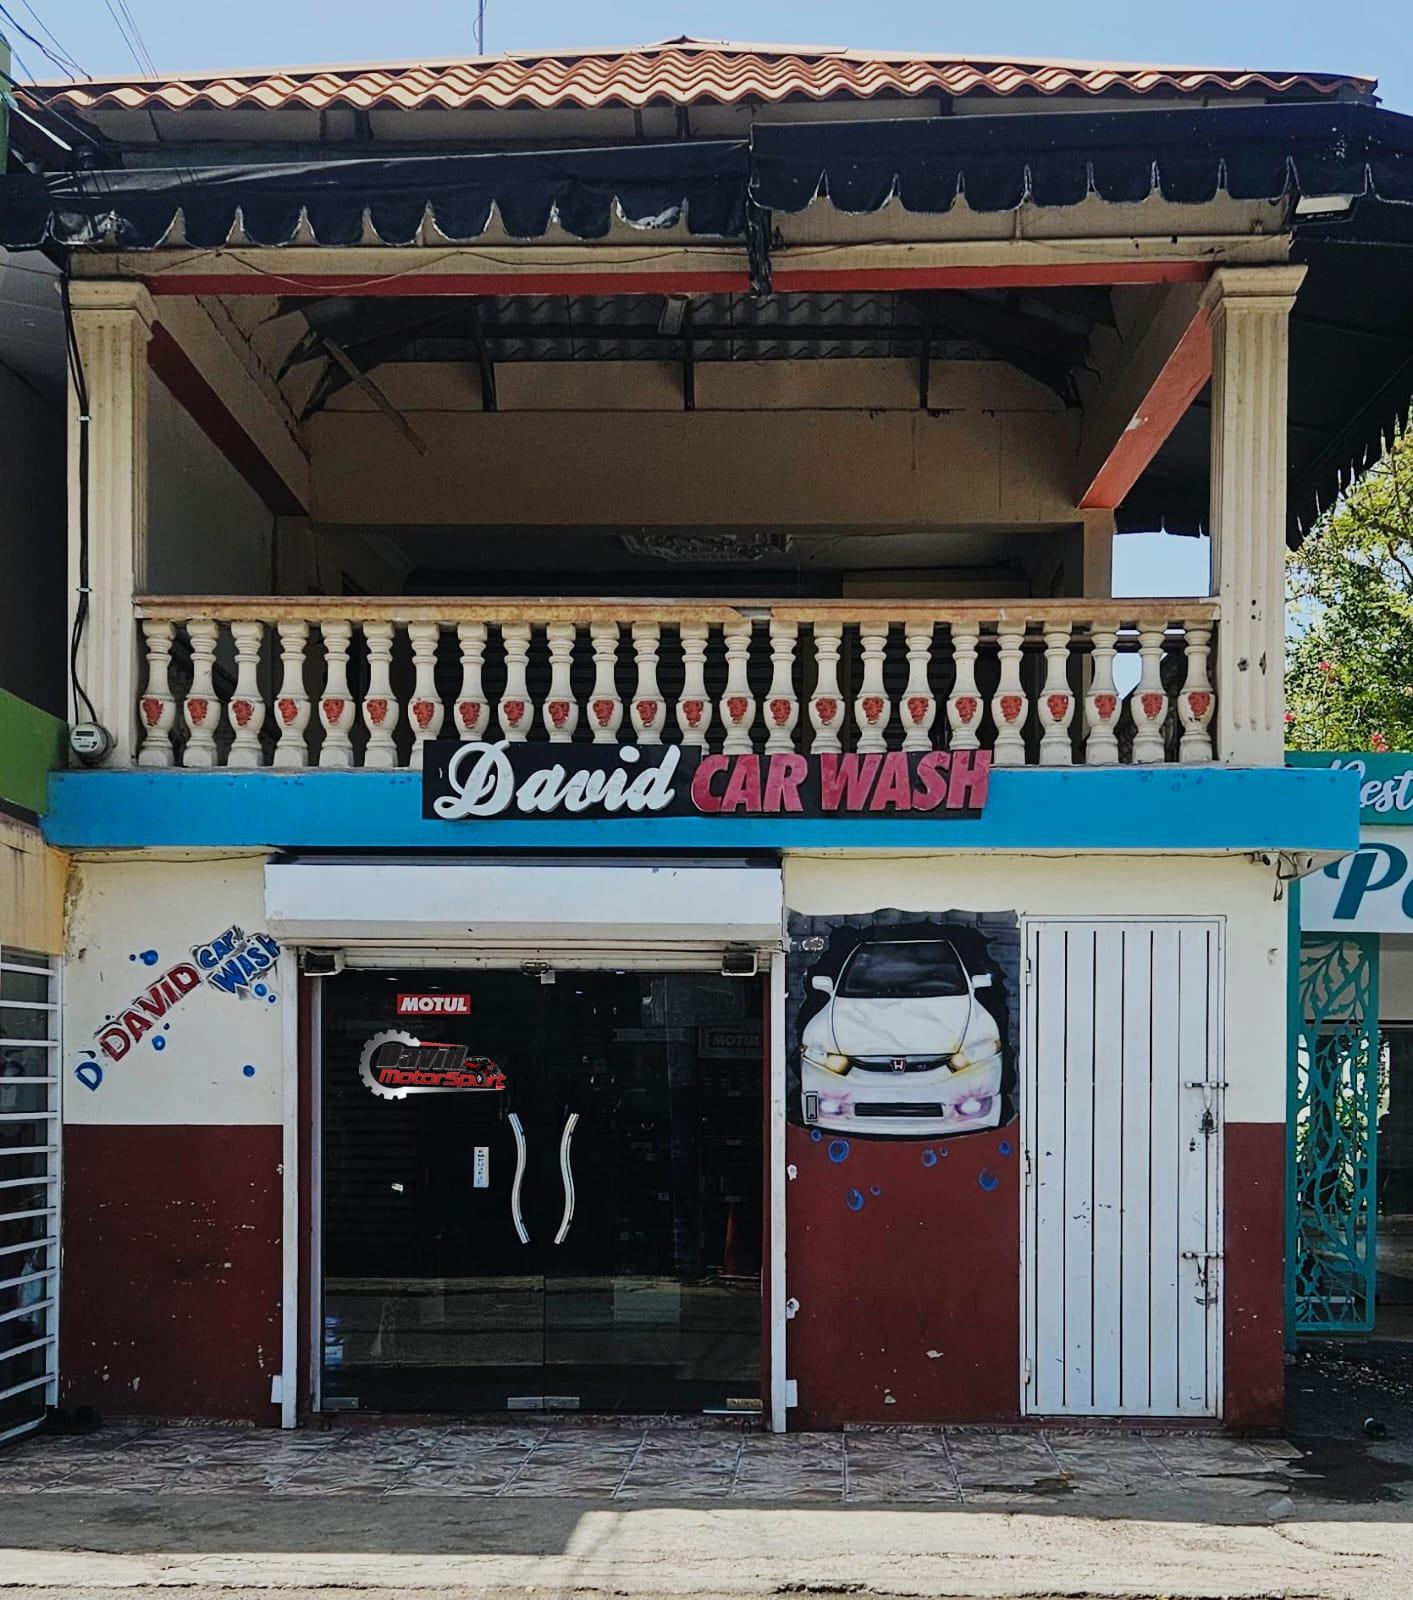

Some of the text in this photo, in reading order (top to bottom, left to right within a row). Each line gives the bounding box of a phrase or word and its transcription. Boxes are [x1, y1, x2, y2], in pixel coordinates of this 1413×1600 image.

[434, 740, 990, 819] David CAR WASH
[1330, 760, 1413, 813] est
[1324, 843, 1413, 919] P
[211, 935, 280, 994] WASH
[98, 965, 201, 1062] DAVID
[400, 997, 468, 1012] MOTUL
